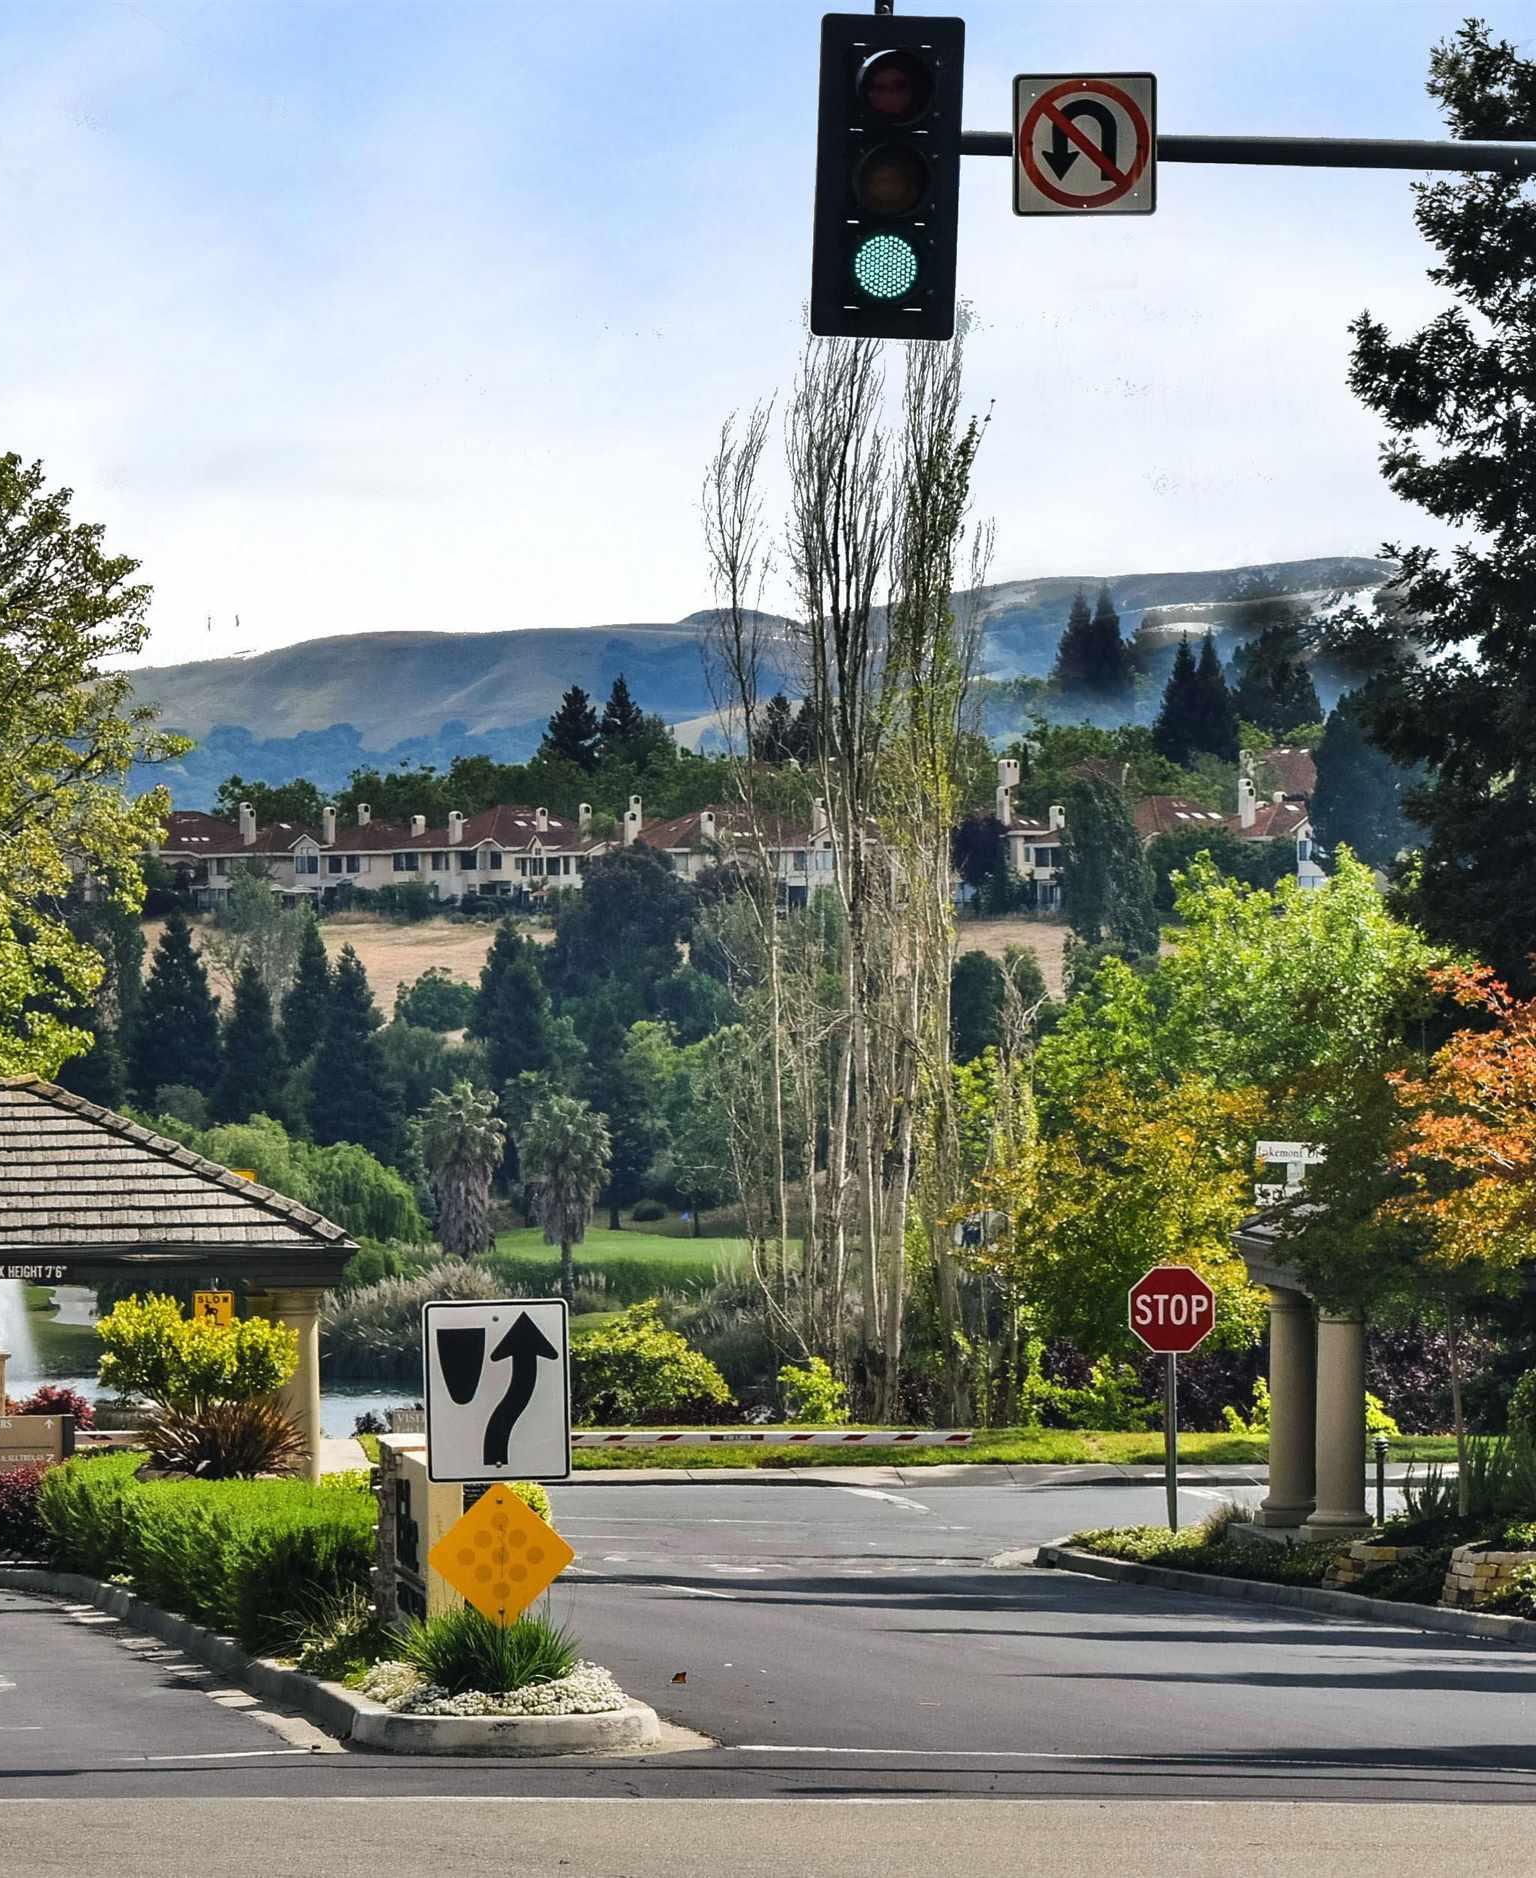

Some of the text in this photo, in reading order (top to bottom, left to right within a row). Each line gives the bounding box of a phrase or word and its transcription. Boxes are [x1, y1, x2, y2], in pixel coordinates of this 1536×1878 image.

[8, 1265, 43, 1279] HEIGHT
[197, 1295, 230, 1304] SLOW
[1135, 1294, 1209, 1326] STOP
